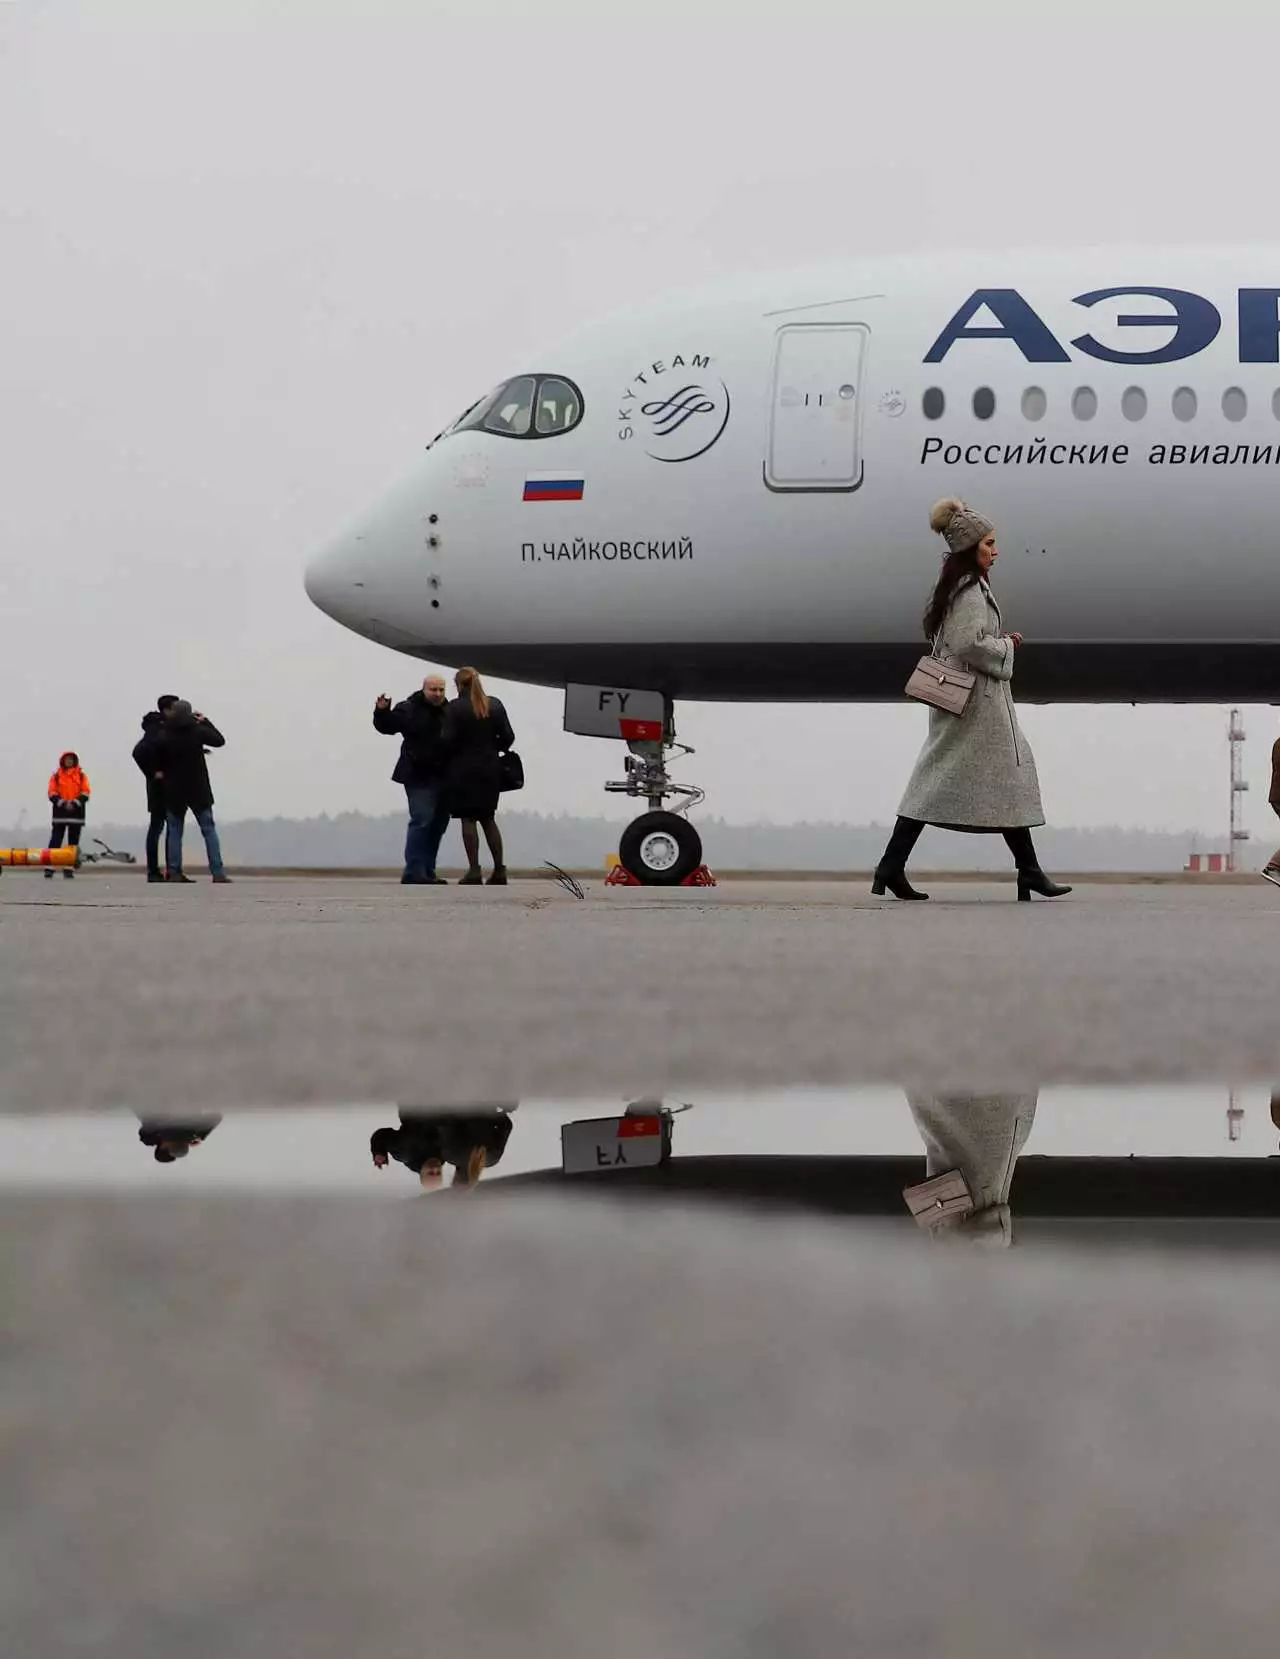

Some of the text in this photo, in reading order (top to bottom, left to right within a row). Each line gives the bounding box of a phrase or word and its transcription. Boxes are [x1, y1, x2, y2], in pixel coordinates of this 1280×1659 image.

[618, 353, 711, 441] SKYTEAM
[920, 437, 1129, 465] Российские
[521, 535, 694, 562] П.ЧАЙКОВСКИЙ
[598, 690, 631, 713] FY
